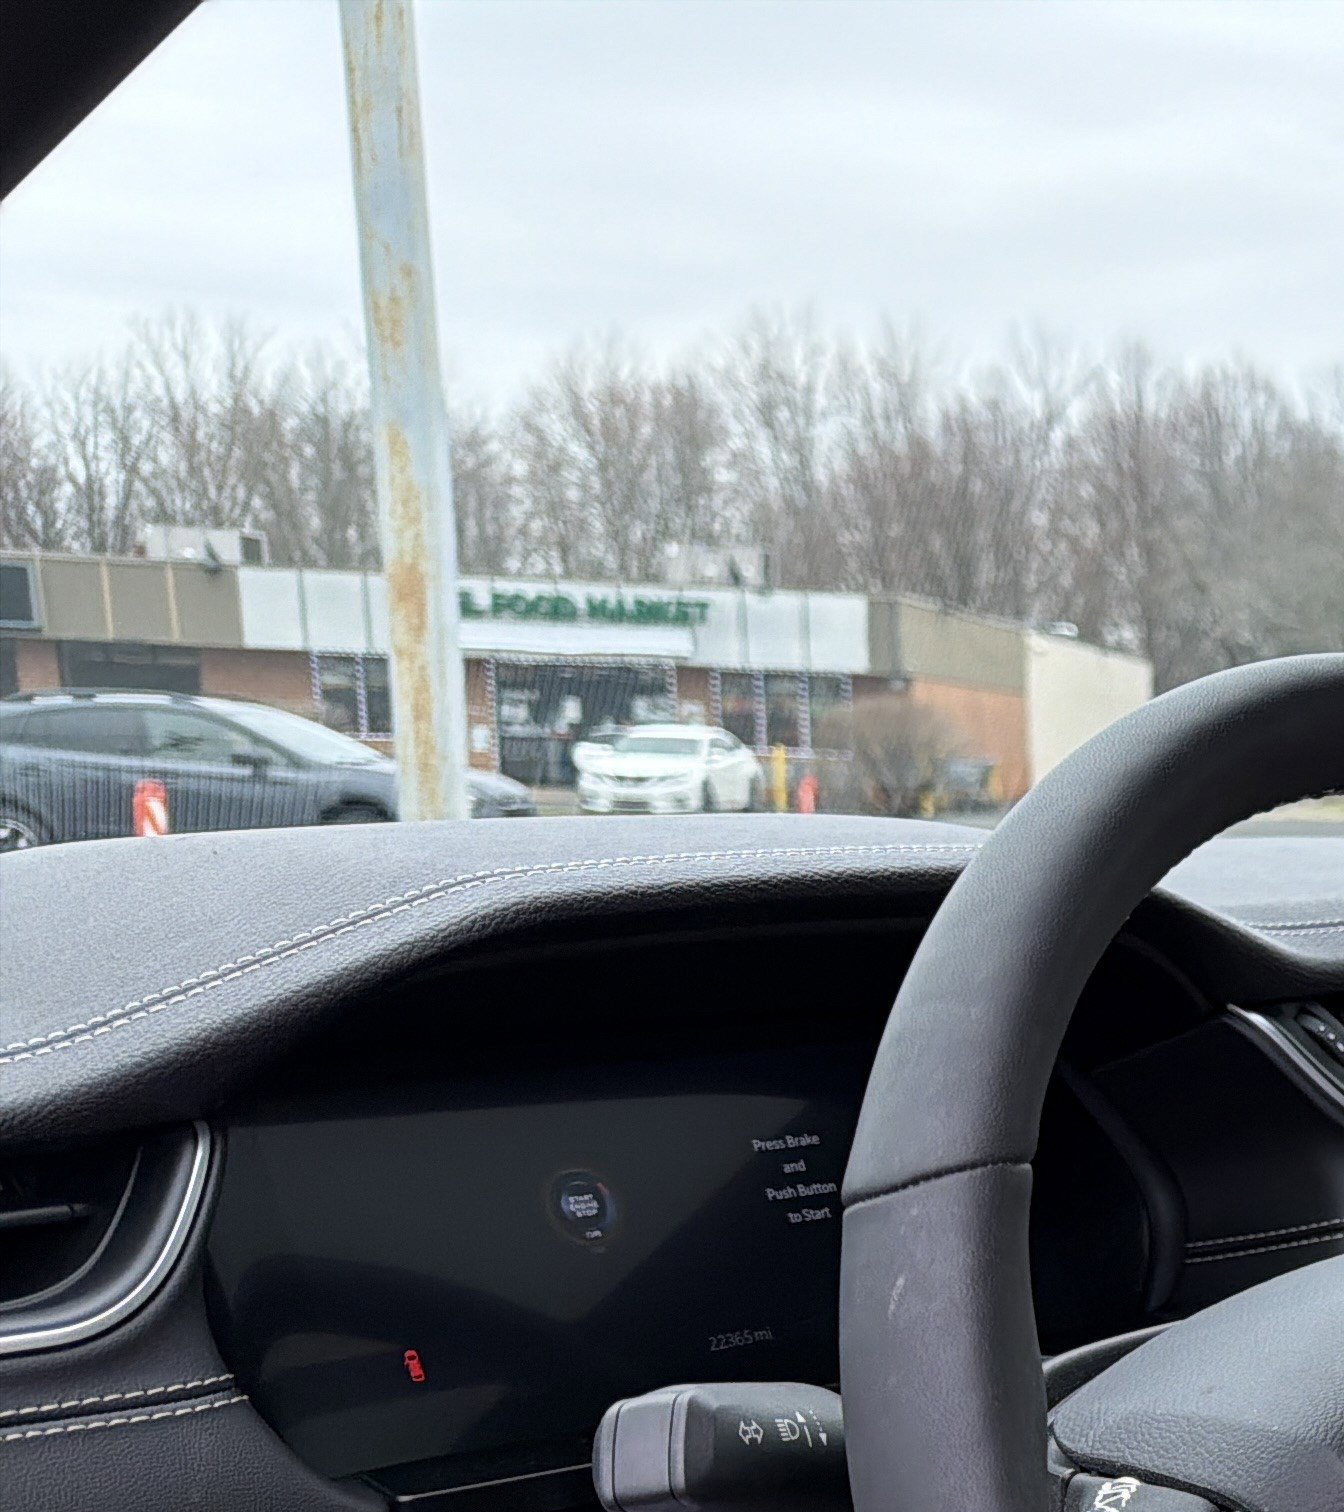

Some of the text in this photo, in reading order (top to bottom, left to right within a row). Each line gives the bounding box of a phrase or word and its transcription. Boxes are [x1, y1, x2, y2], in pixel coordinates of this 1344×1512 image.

[491, 592, 578, 621] FOOD
[586, 595, 710, 624] MARKET
[752, 1134, 820, 1152] Press Brake
[784, 1159, 806, 1173] and
[765, 1183, 837, 1201] Push Button
[787, 1207, 832, 1223] to Start
[709, 1326, 772, 1351] 22365 mi
